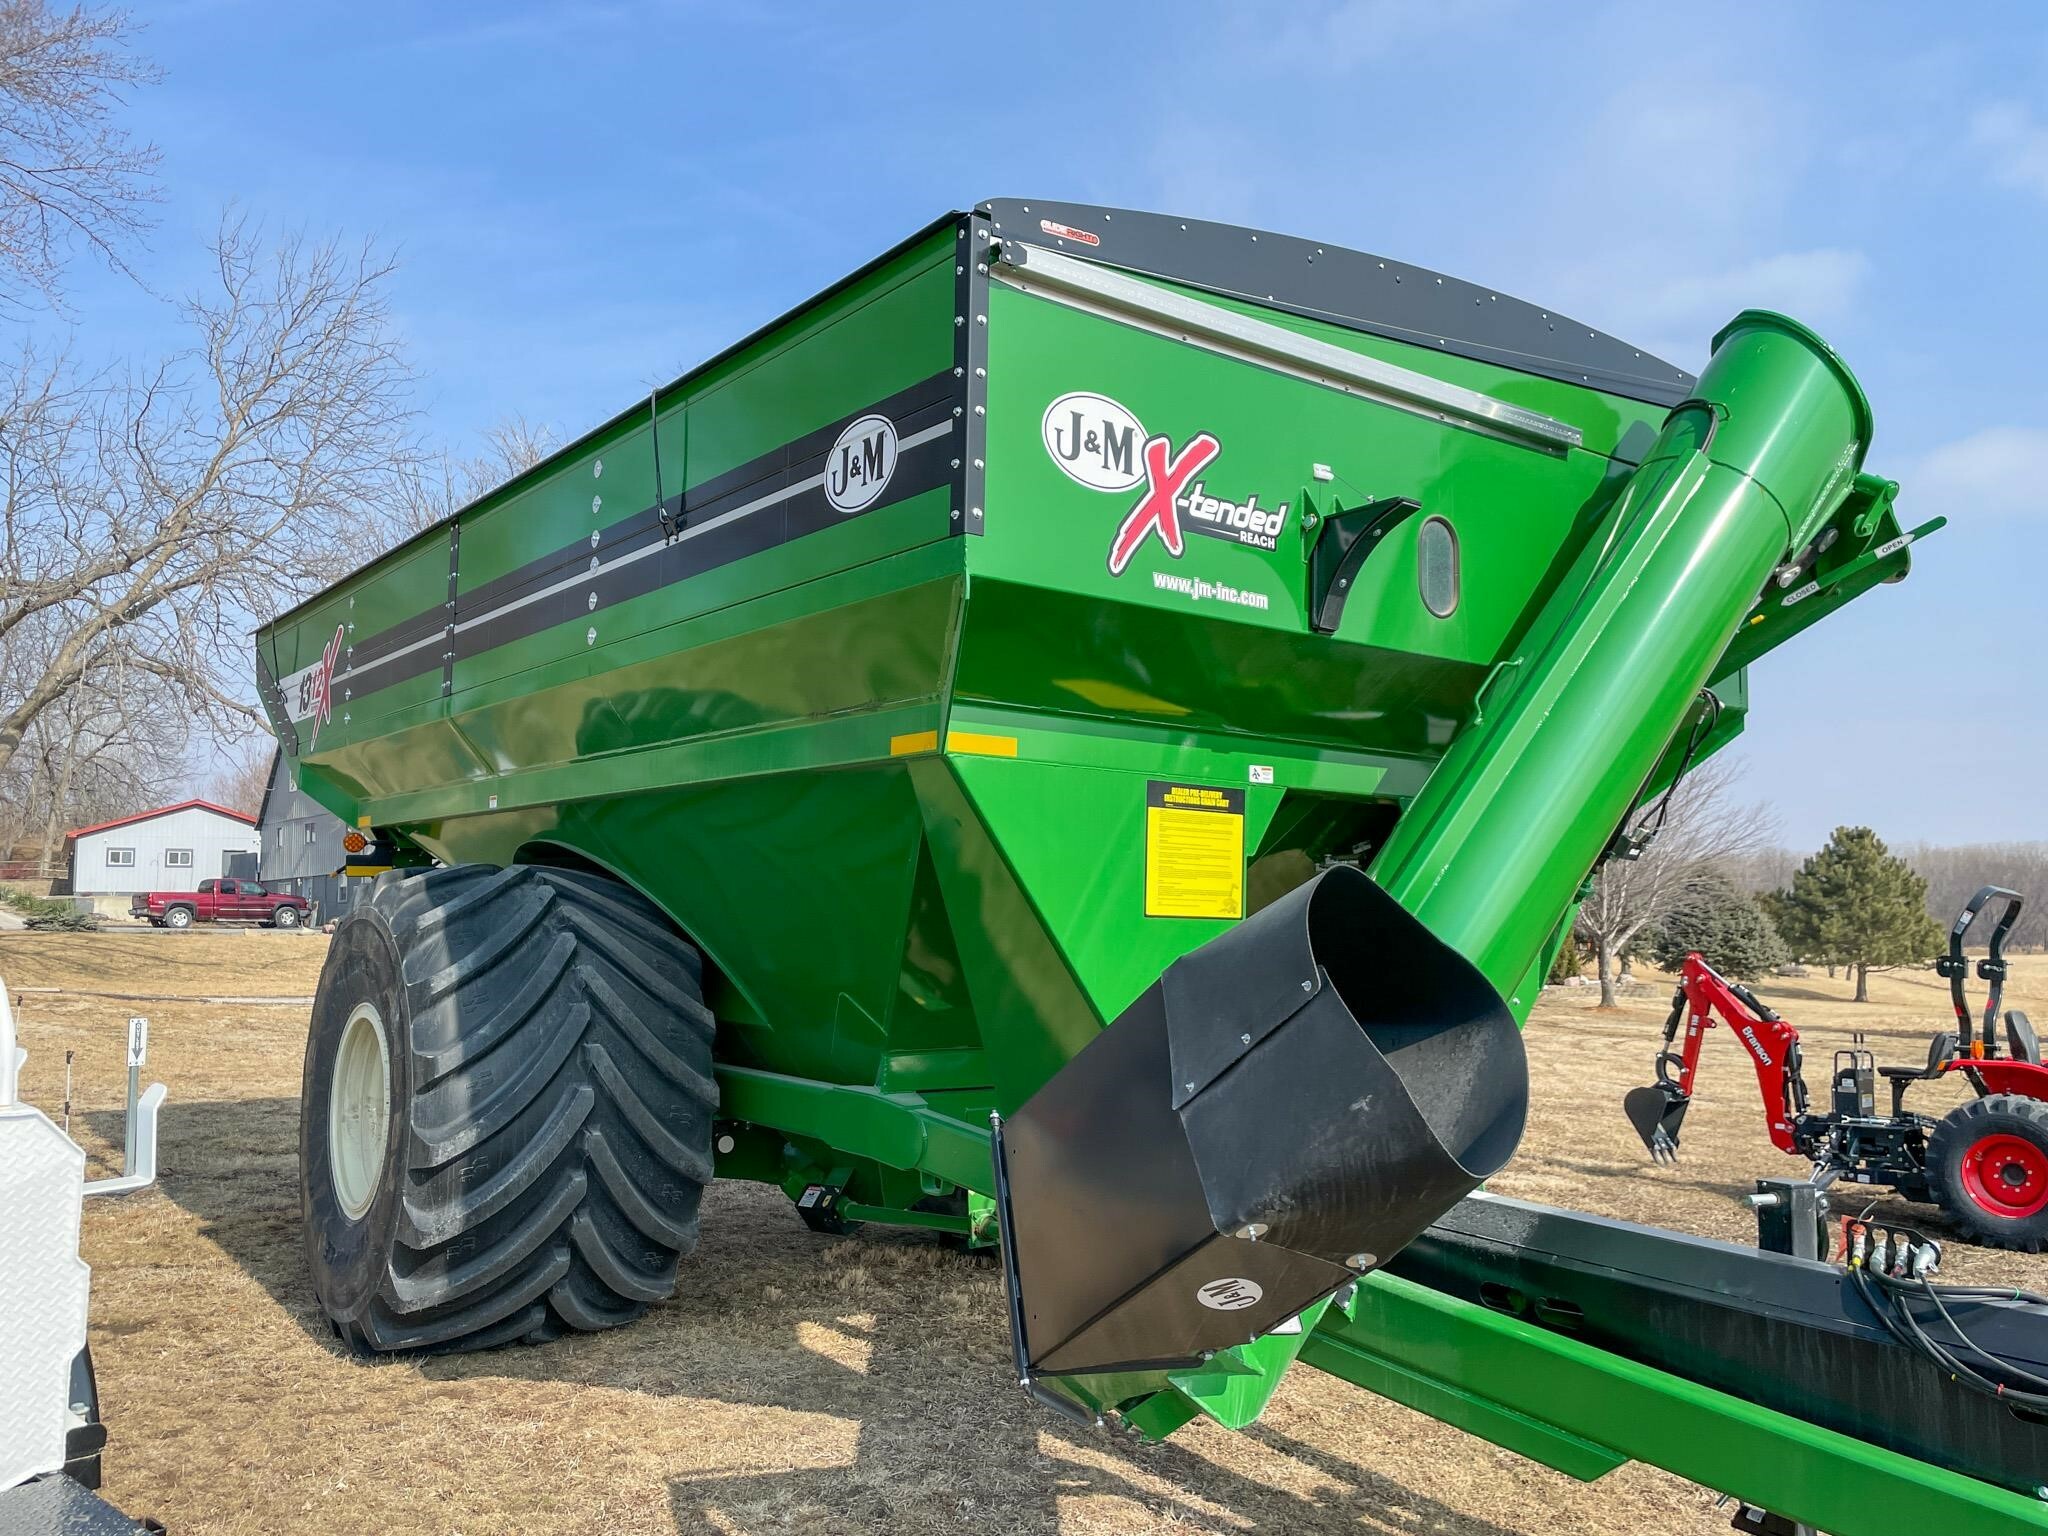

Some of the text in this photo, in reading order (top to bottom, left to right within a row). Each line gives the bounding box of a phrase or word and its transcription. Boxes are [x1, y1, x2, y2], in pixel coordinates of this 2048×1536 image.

[1054, 410, 1136, 477] J&M
[831, 430, 886, 497] J&M
[1239, 530, 1276, 550] REACH
[1881, 538, 1904, 554] OPEN
[1152, 571, 1269, 610] www.jm-inc.com
[1786, 582, 1817, 604] CLOSED
[1742, 1026, 1772, 1066] Branson
[1201, 1279, 1257, 1307] J&M
